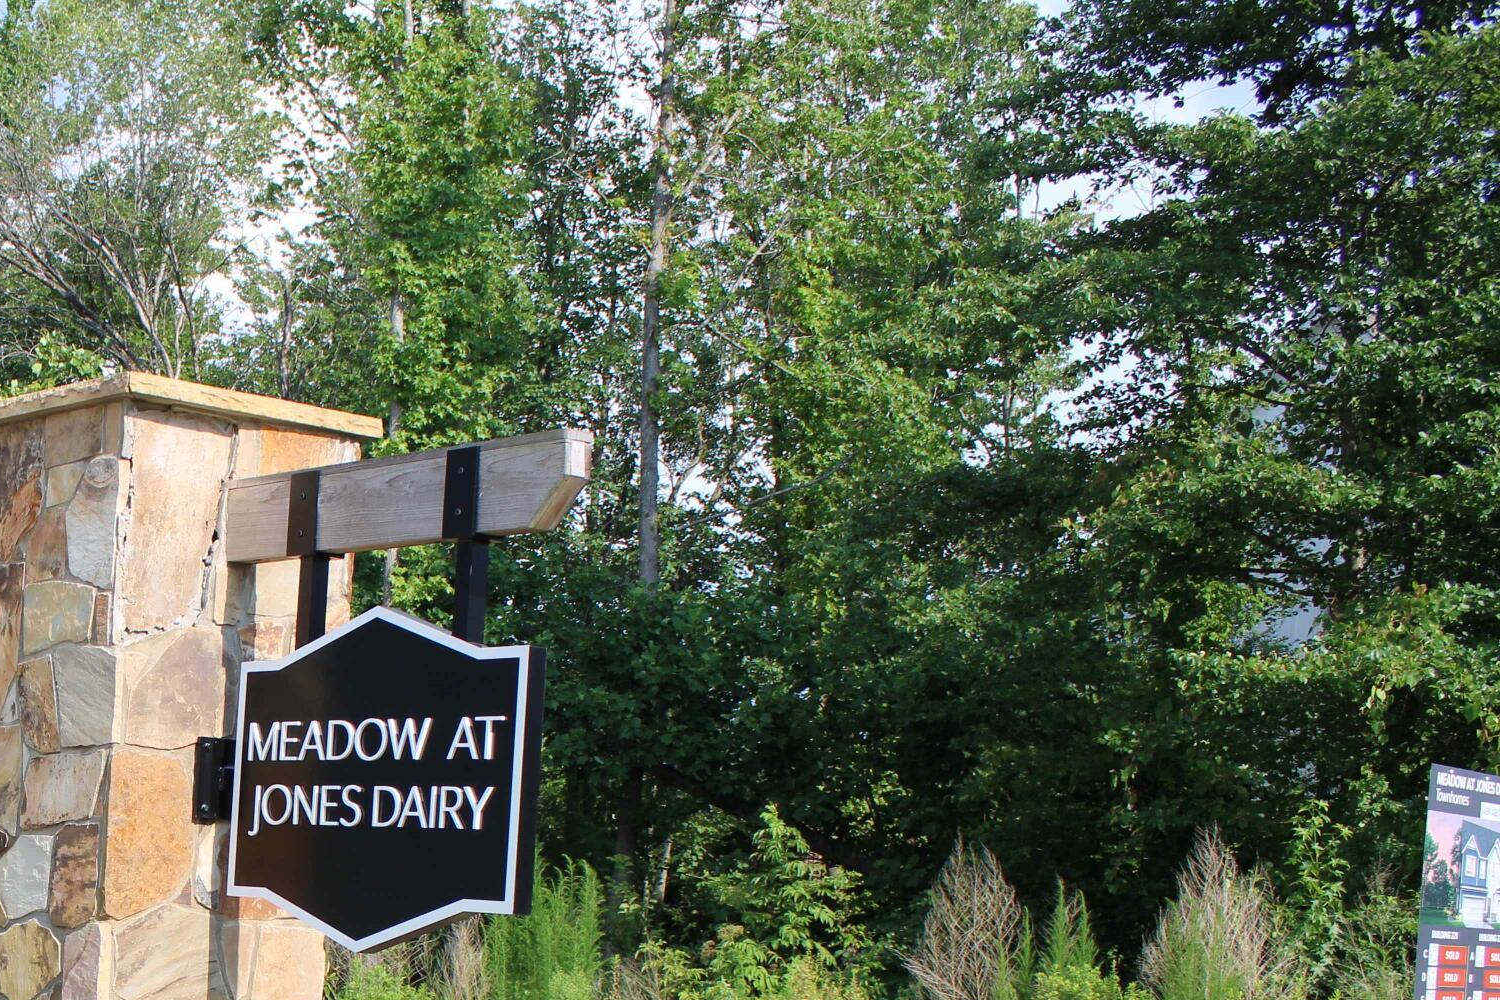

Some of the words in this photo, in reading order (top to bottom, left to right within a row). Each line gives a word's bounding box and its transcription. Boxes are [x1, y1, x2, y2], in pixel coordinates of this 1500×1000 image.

[247, 717, 433, 762] MEADOW
[447, 715, 507, 760] AT
[1436, 772, 1466, 790] MEADOW
[1466, 778, 1475, 791] AT
[1475, 780, 1495, 795] JONES
[1436, 788, 1469, 806] Townhomes
[247, 784, 363, 836] JONES
[371, 785, 496, 830] DAIRY
[1445, 951, 1459, 960] SOLD
[1491, 953, 1500, 961] SOL
[1444, 973, 1458, 982] SOLD
[1490, 975, 1500, 983] SOL
